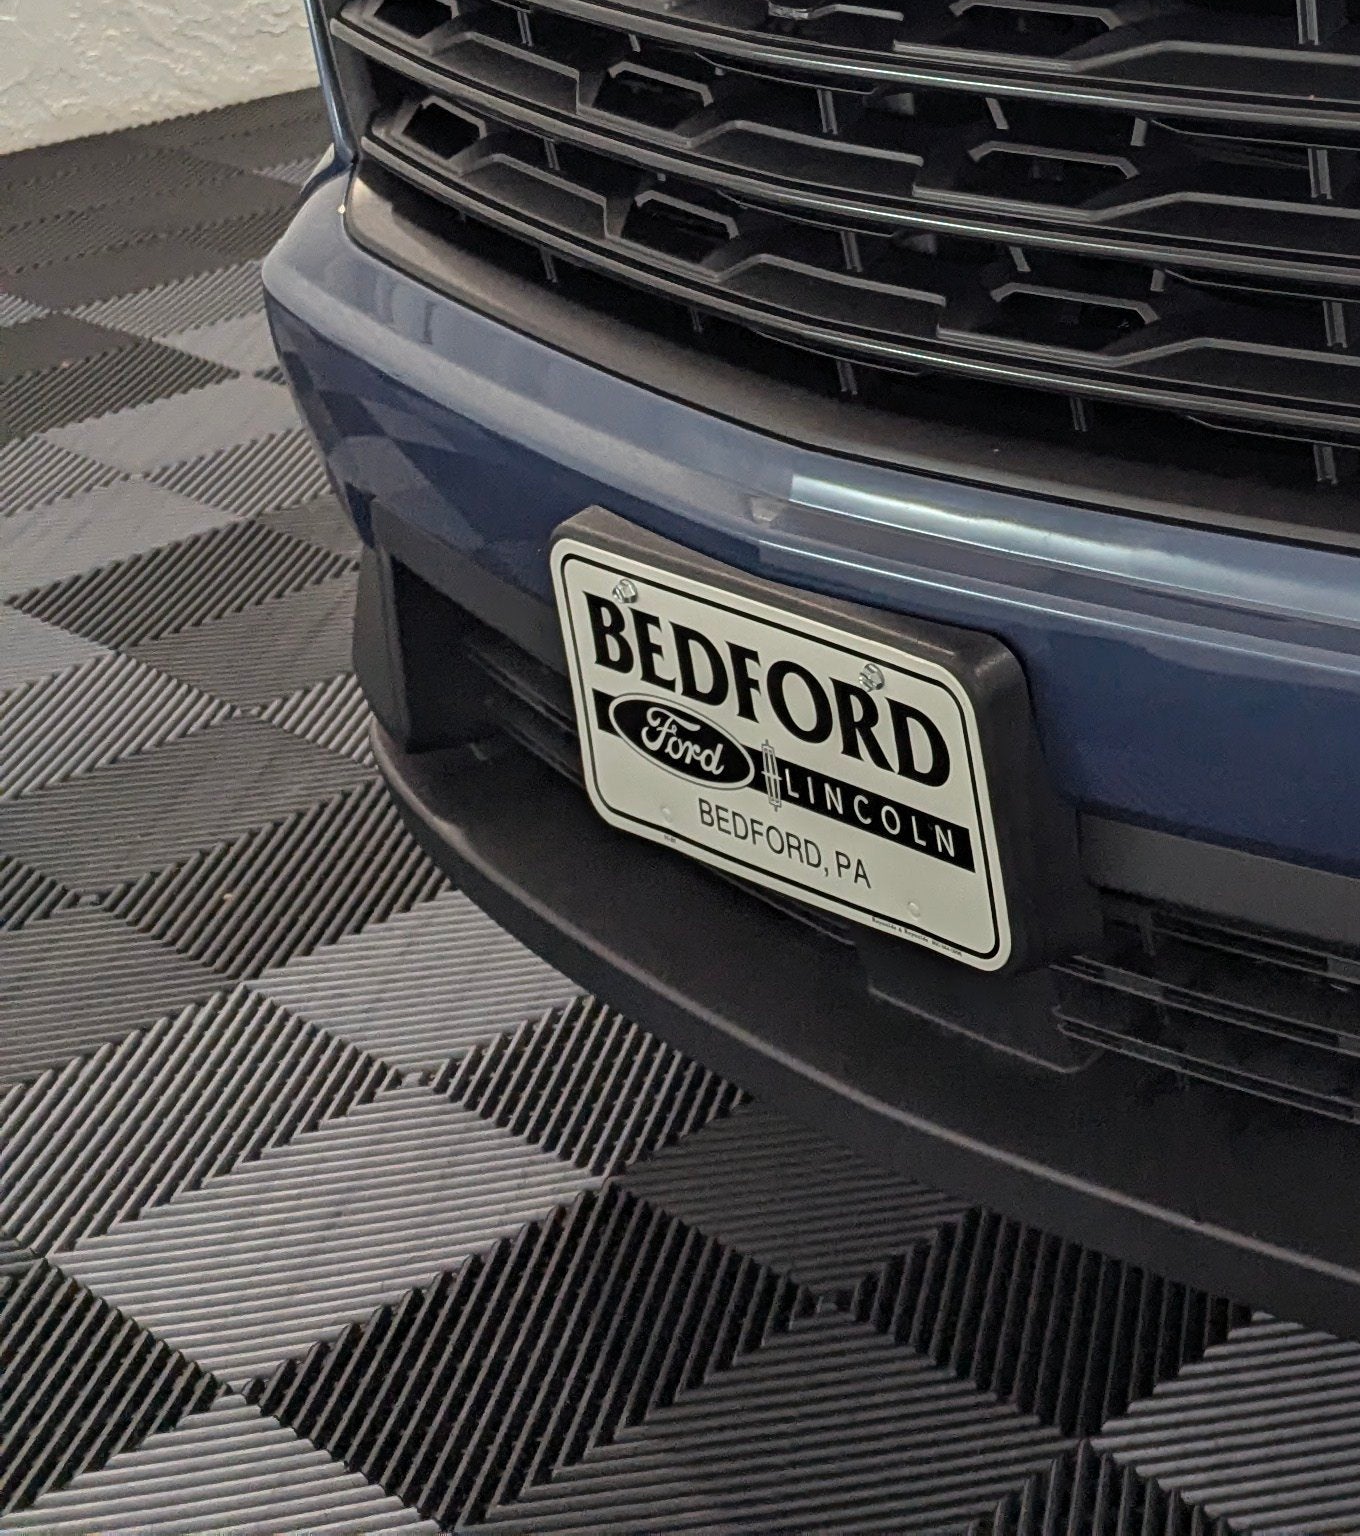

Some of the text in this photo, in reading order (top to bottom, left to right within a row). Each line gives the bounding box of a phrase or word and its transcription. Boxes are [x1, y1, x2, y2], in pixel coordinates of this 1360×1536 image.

[583, 590, 951, 788] BEDFORD
[641, 706, 725, 775] Ford
[699, 798, 872, 889] BEDFORD, PA
[785, 766, 957, 858] LINCOLN
